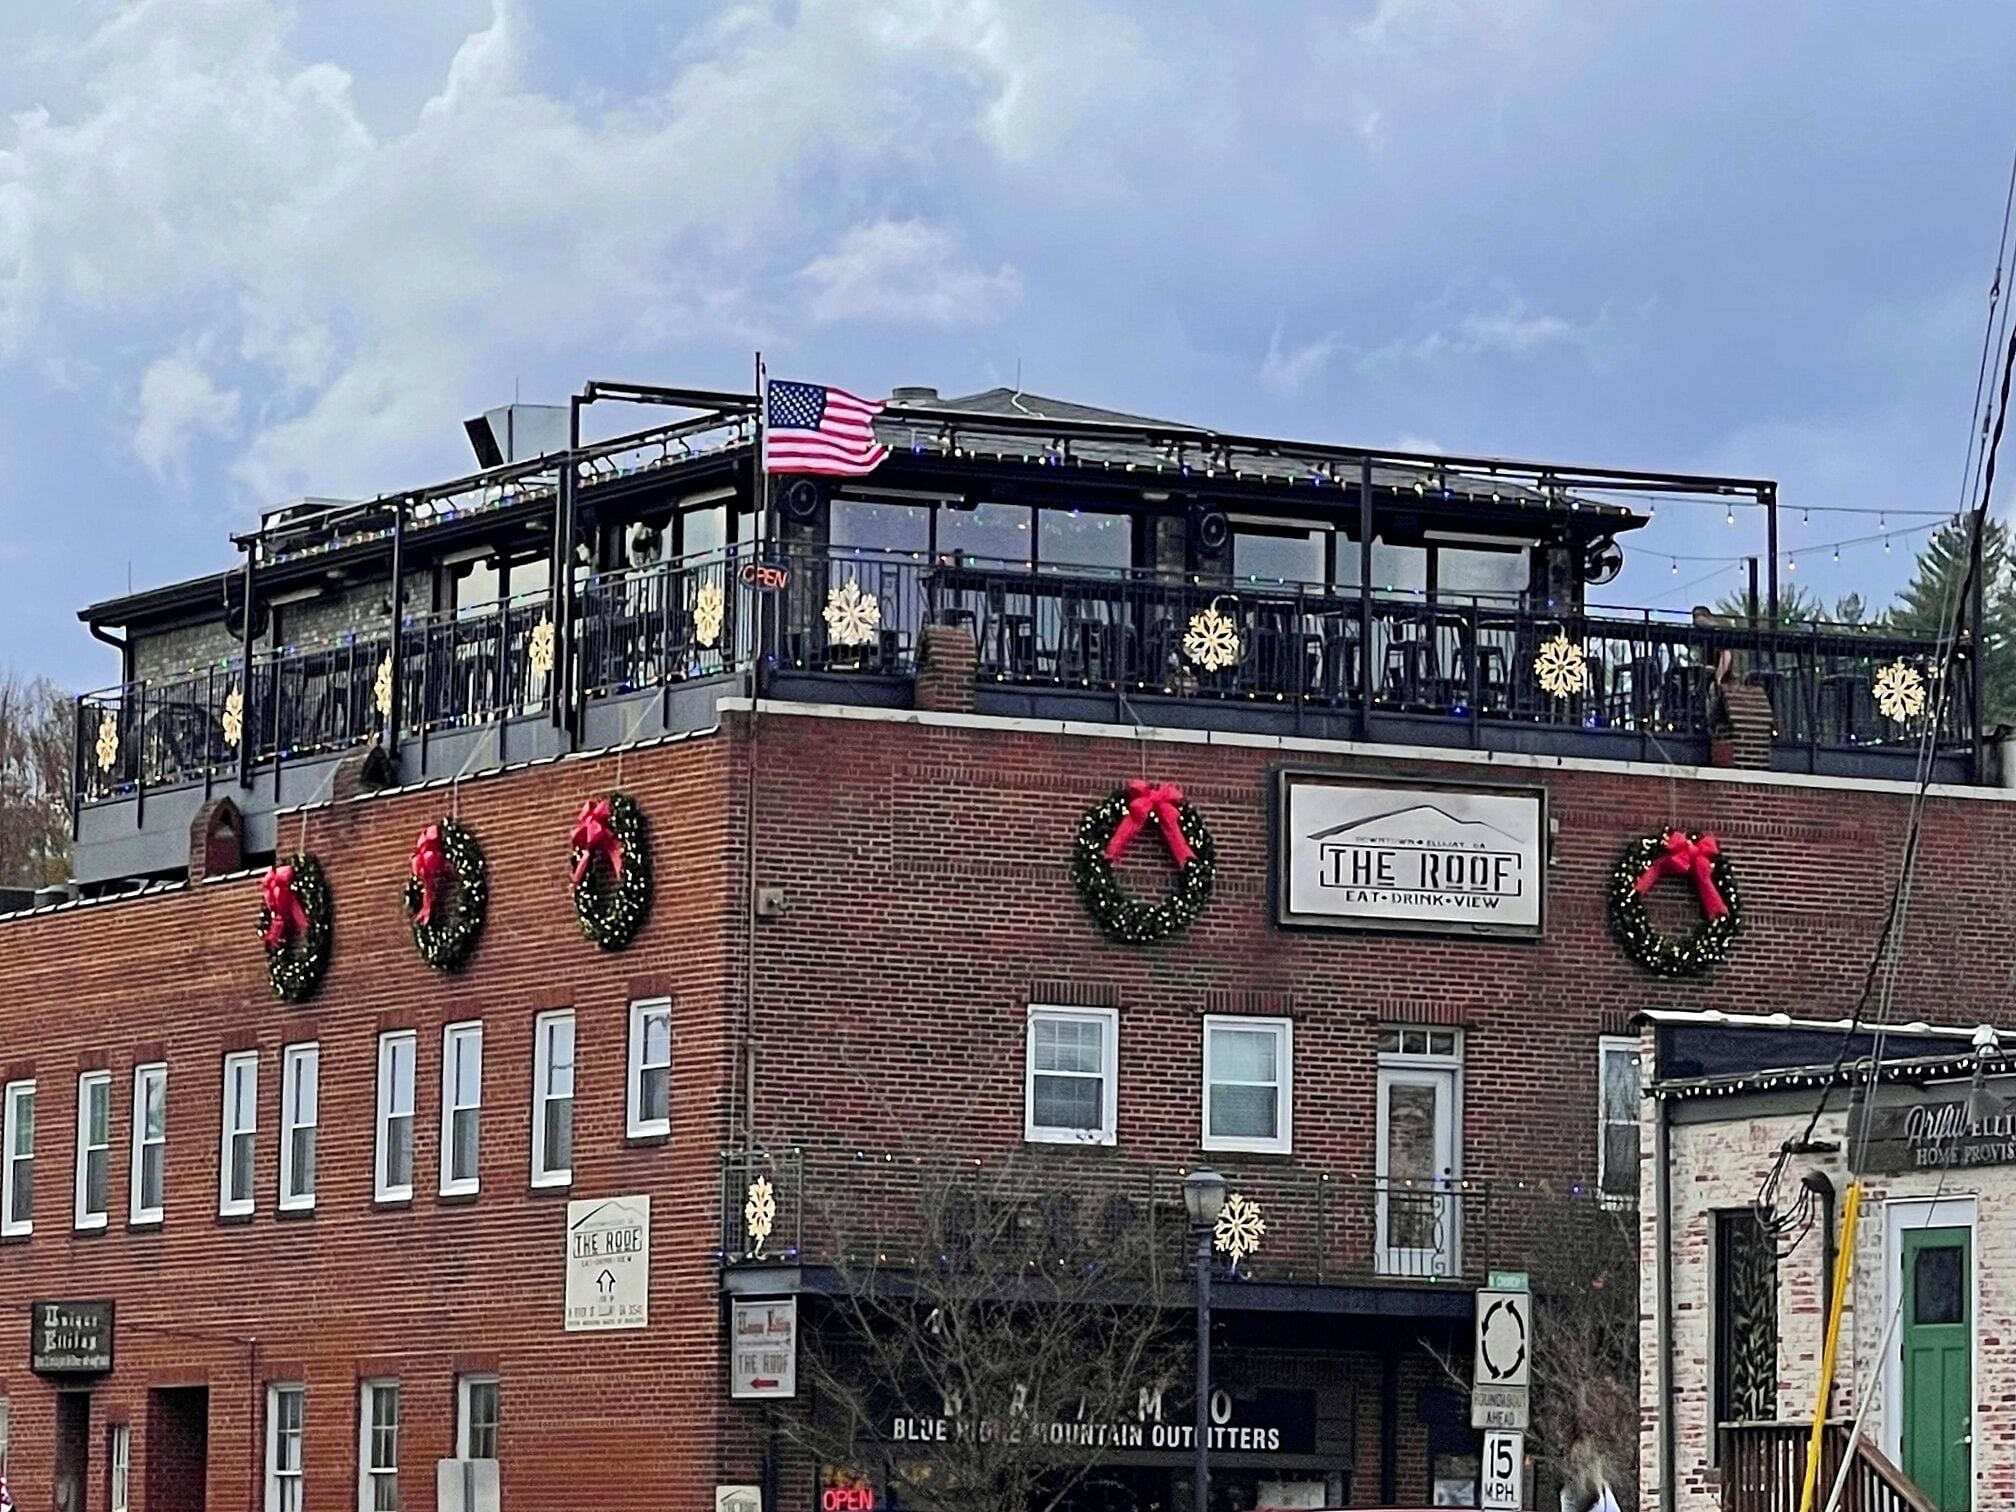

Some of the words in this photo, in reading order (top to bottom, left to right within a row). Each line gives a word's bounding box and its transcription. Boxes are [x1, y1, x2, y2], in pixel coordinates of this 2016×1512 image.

[743, 565, 788, 589] OPEN
[1328, 849, 1396, 887] THE
[1420, 852, 1512, 892] ROOF
[1346, 890, 1380, 903] EAT
[1391, 892, 1444, 906] DRINK
[1454, 895, 1500, 909] VIEW
[1971, 1115, 2016, 1140] ELLI
[1916, 1147, 1960, 1165] HOME
[575, 1233, 598, 1256] THE
[606, 1229, 640, 1253] ROOF
[893, 1418, 948, 1441] BLUE
[1152, 1424, 1280, 1450] OUTITTERS
[1489, 1439, 1513, 1479] 15
[823, 1488, 873, 1511] OPEN
